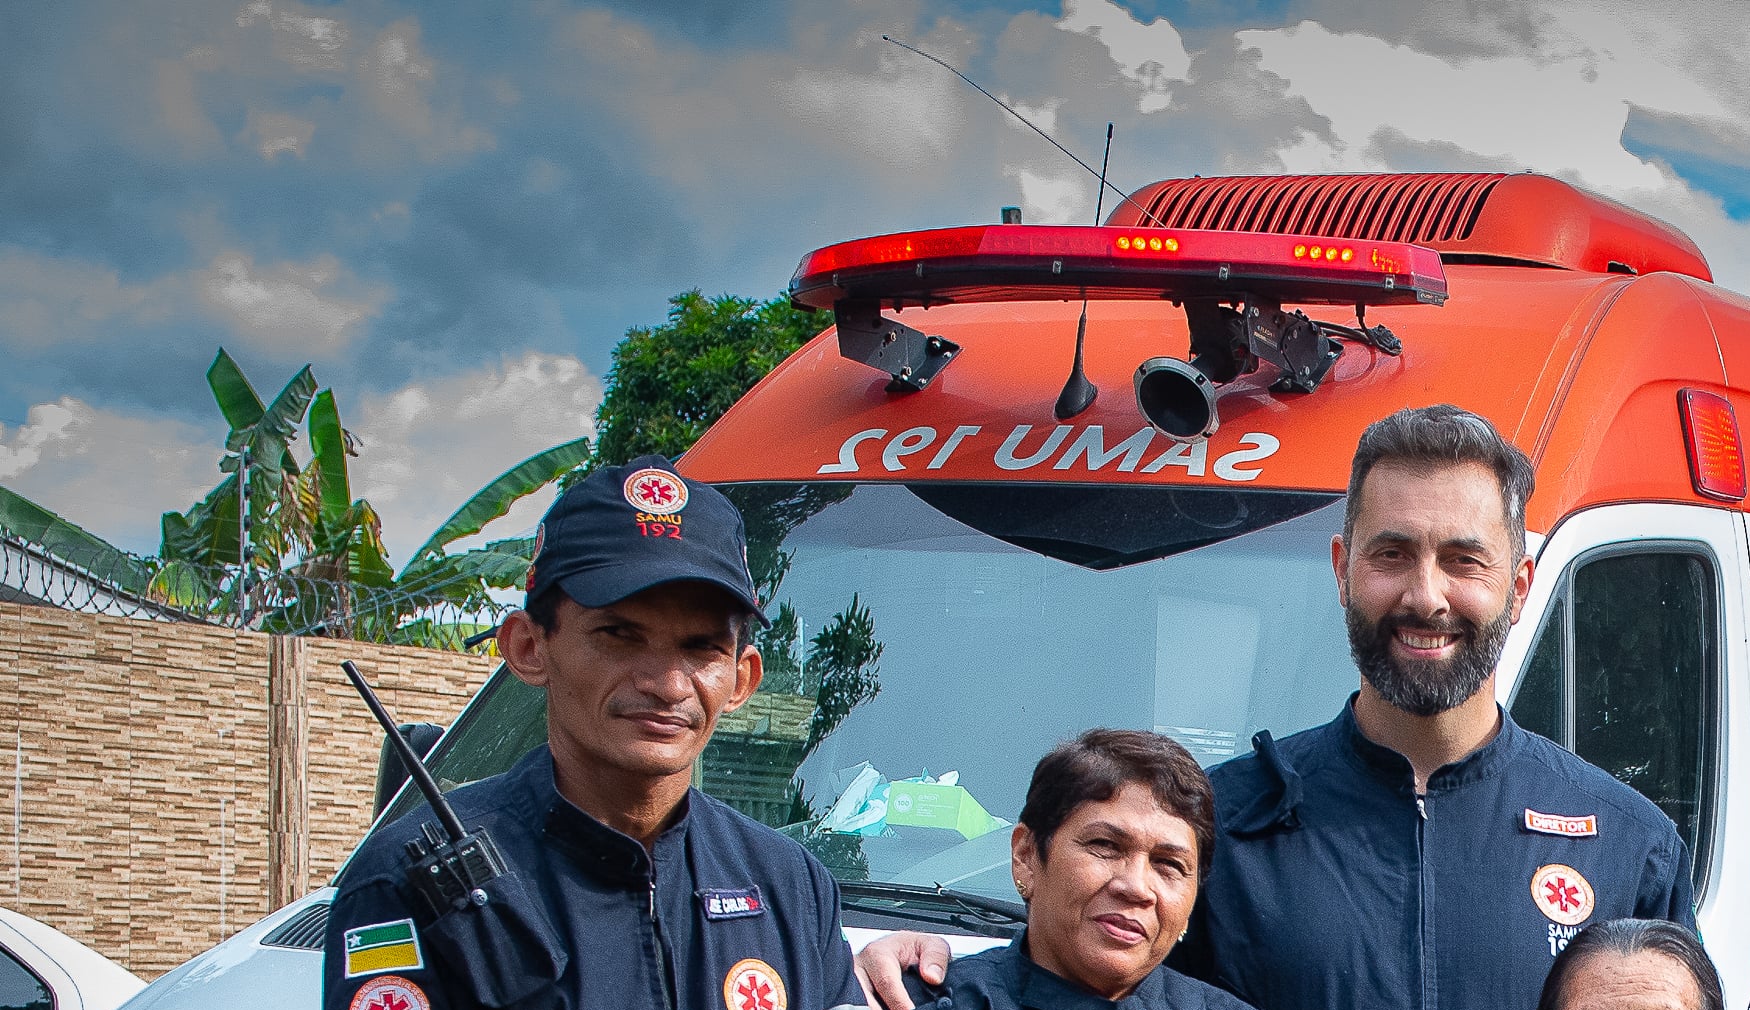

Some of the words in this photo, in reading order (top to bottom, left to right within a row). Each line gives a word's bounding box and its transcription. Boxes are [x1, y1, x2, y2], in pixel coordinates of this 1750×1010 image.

[635, 512, 682, 525] SAMU
[635, 522, 683, 541] 192
[1532, 817, 1588, 832] DIRETOR
